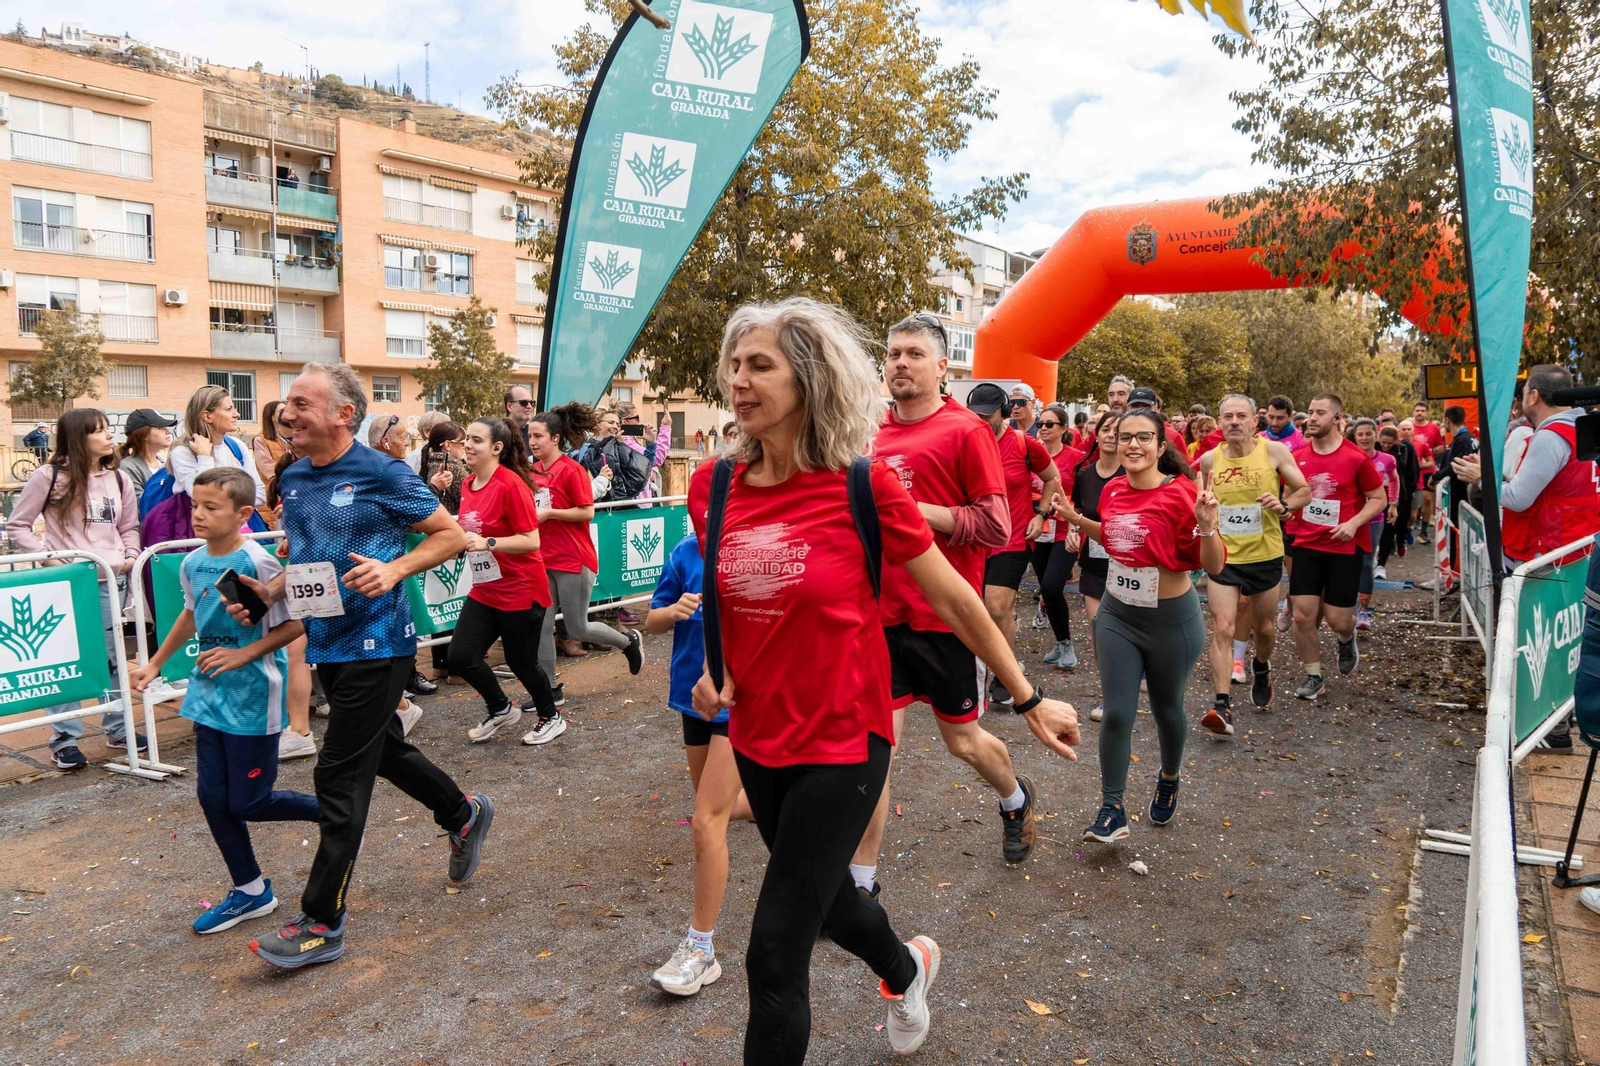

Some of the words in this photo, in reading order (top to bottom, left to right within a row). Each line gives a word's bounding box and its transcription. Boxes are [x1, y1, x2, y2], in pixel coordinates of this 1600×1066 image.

[653, 0, 679, 79] fundación
[651, 81, 692, 101] CAJA
[695, 88, 754, 112] RURAL
[670, 101, 730, 120] GRANADA
[604, 132, 622, 197] fundación
[603, 200, 637, 215] CAJA
[638, 205, 685, 223] RURAL
[618, 215, 666, 229] GRANADA
[574, 241, 587, 290] fundación
[573, 291, 599, 304] CAJA
[598, 296, 634, 310] RURAL
[583, 303, 620, 314] GRANADA
[1309, 505, 1331, 517] 594
[1228, 515, 1251, 525] 424
[786, 546, 806, 560] de
[621, 570, 640, 582] CAJA
[717, 562, 806, 575] HUMANIDAD
[630, 577, 656, 587] GRANADA
[1117, 575, 1141, 591] 919
[292, 583, 325, 599] 1399
[1554, 602, 1581, 649] CAJA
[16, 664, 83, 689] RURAL
[300, 936, 326, 953] HOKA
